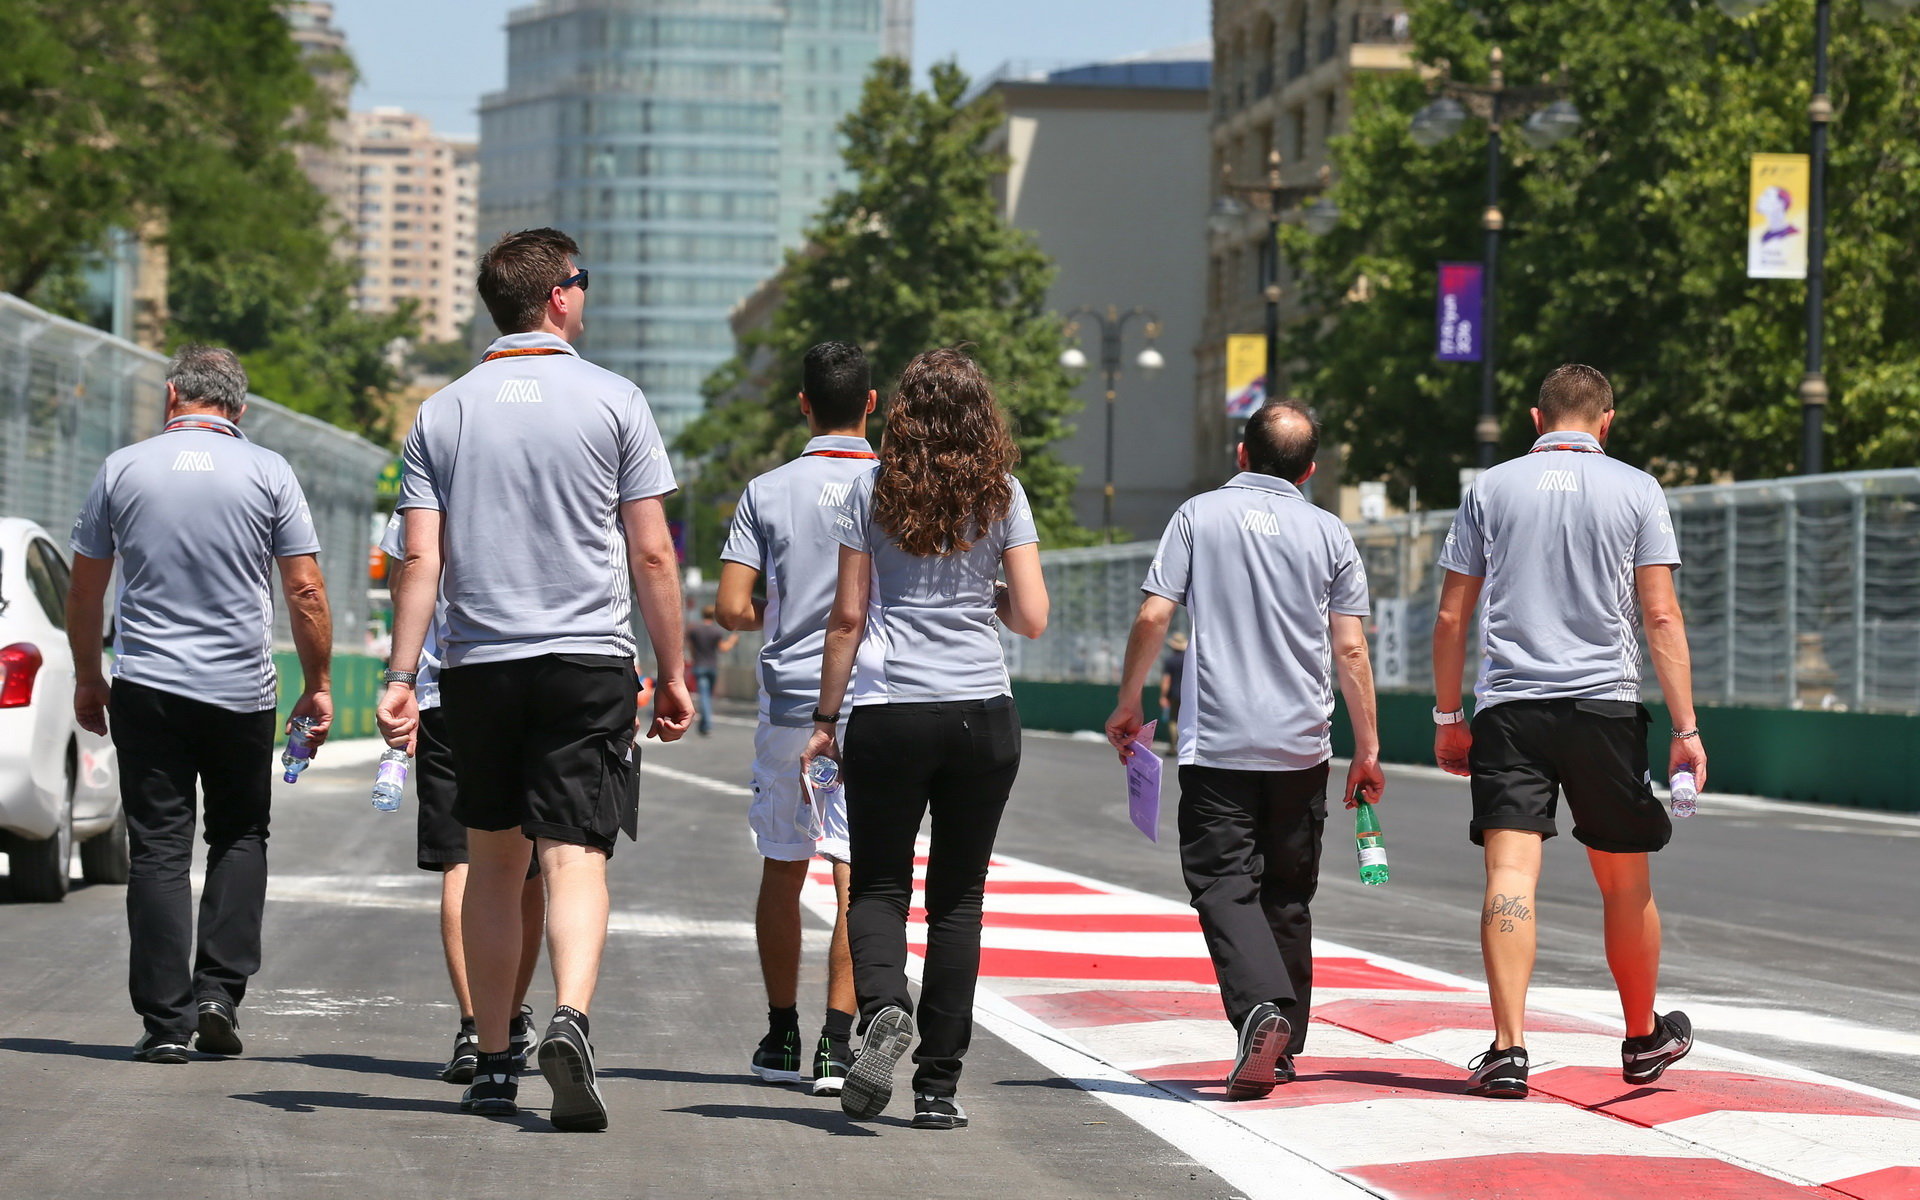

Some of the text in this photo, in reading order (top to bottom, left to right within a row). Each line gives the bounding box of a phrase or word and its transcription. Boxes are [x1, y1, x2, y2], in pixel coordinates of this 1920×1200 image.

[1455, 320, 1472, 354] 2016
[1484, 893, 1532, 926] Petra
[1499, 919, 1514, 933] 23
